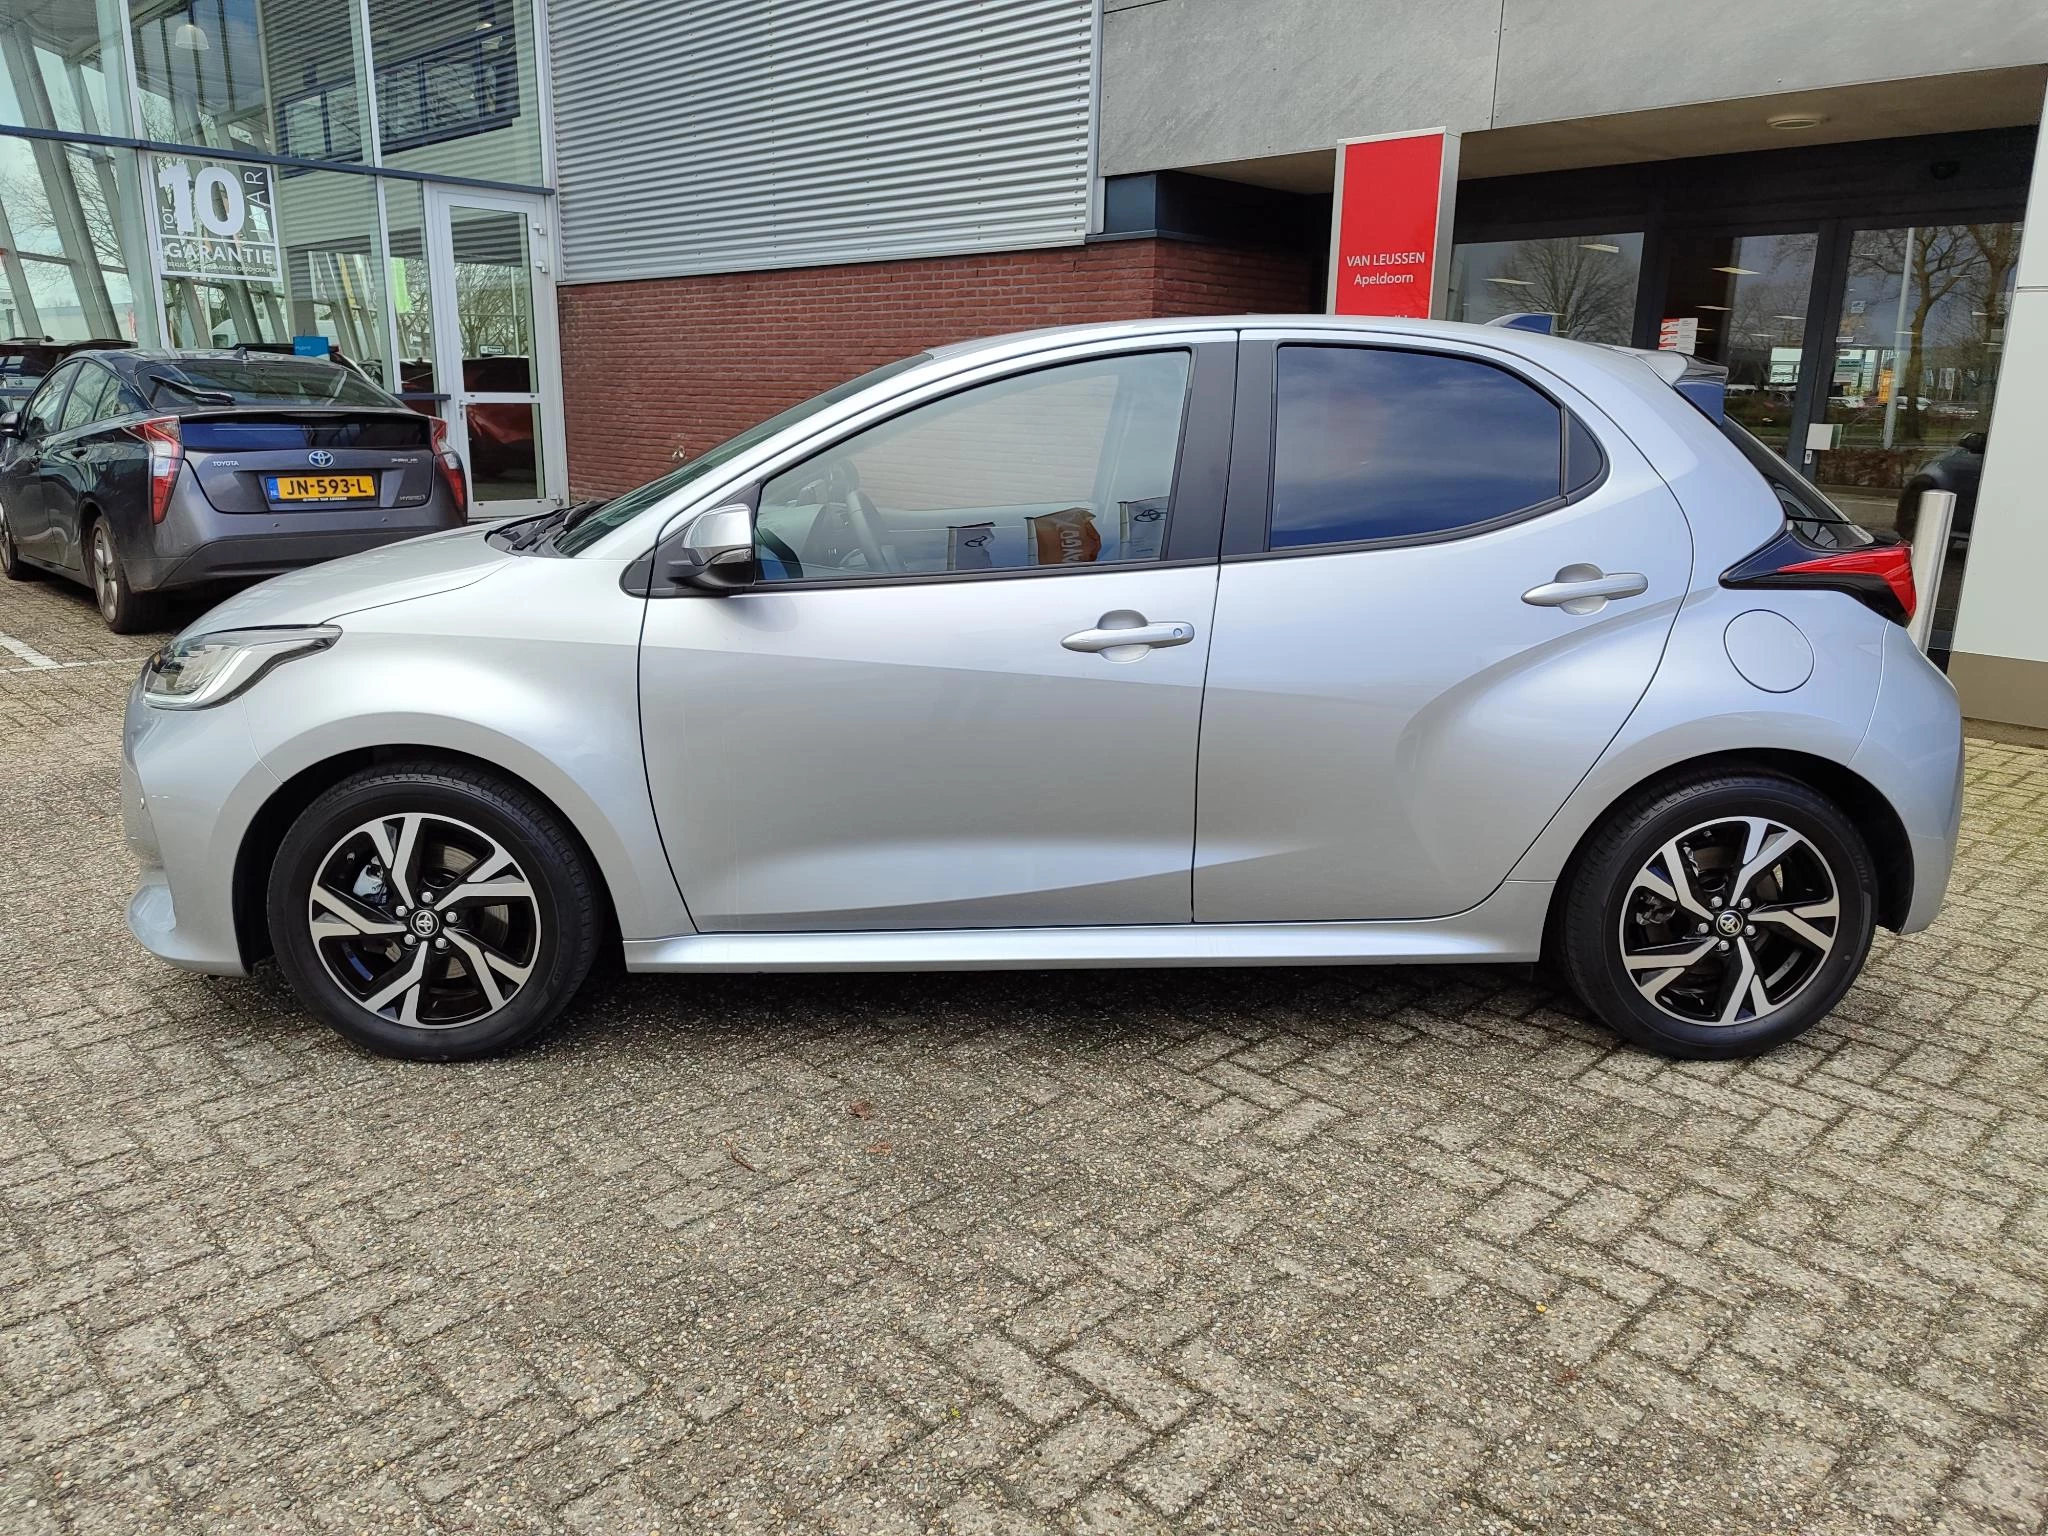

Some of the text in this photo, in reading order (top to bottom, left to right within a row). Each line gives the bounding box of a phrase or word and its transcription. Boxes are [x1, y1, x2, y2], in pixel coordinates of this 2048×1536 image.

[157, 162, 273, 243] TOT 10 JAAR
[166, 242, 273, 265] GARANTIE
[1346, 252, 1425, 267] VAN LEUSSEN
[1353, 272, 1414, 287] Apeldoorn
[286, 477, 367, 496] JN-593-L
